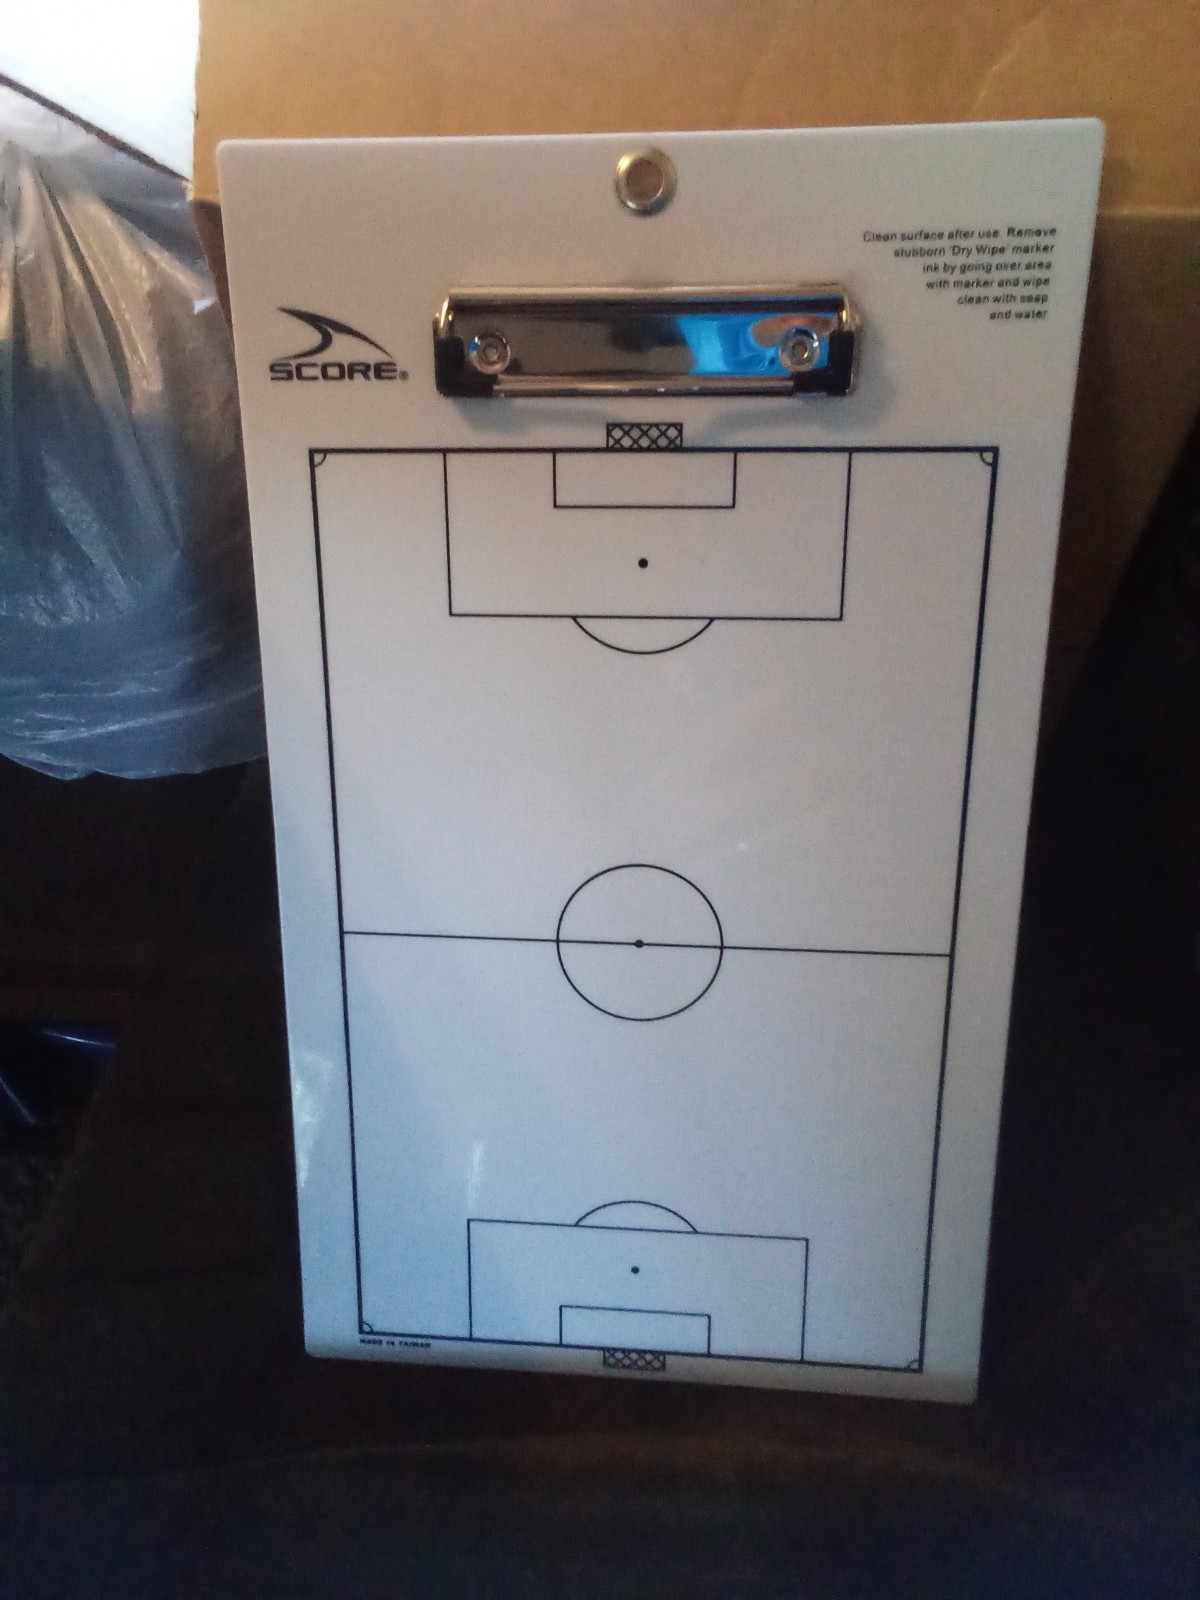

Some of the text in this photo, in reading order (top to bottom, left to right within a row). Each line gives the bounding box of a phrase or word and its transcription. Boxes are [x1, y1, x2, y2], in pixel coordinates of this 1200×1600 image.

[863, 230, 897, 242] Clean
[901, 229, 944, 241] surface
[947, 228, 974, 240] after
[1007, 226, 1056, 238] Remove
[894, 247, 945, 257] stubborn
[1011, 243, 1054, 254] marker
[922, 261, 1052, 274] ink by going over area
[925, 276, 1050, 289] with marker and wipe
[957, 293, 1049, 305] clean with soap
[989, 309, 1012, 320] and
